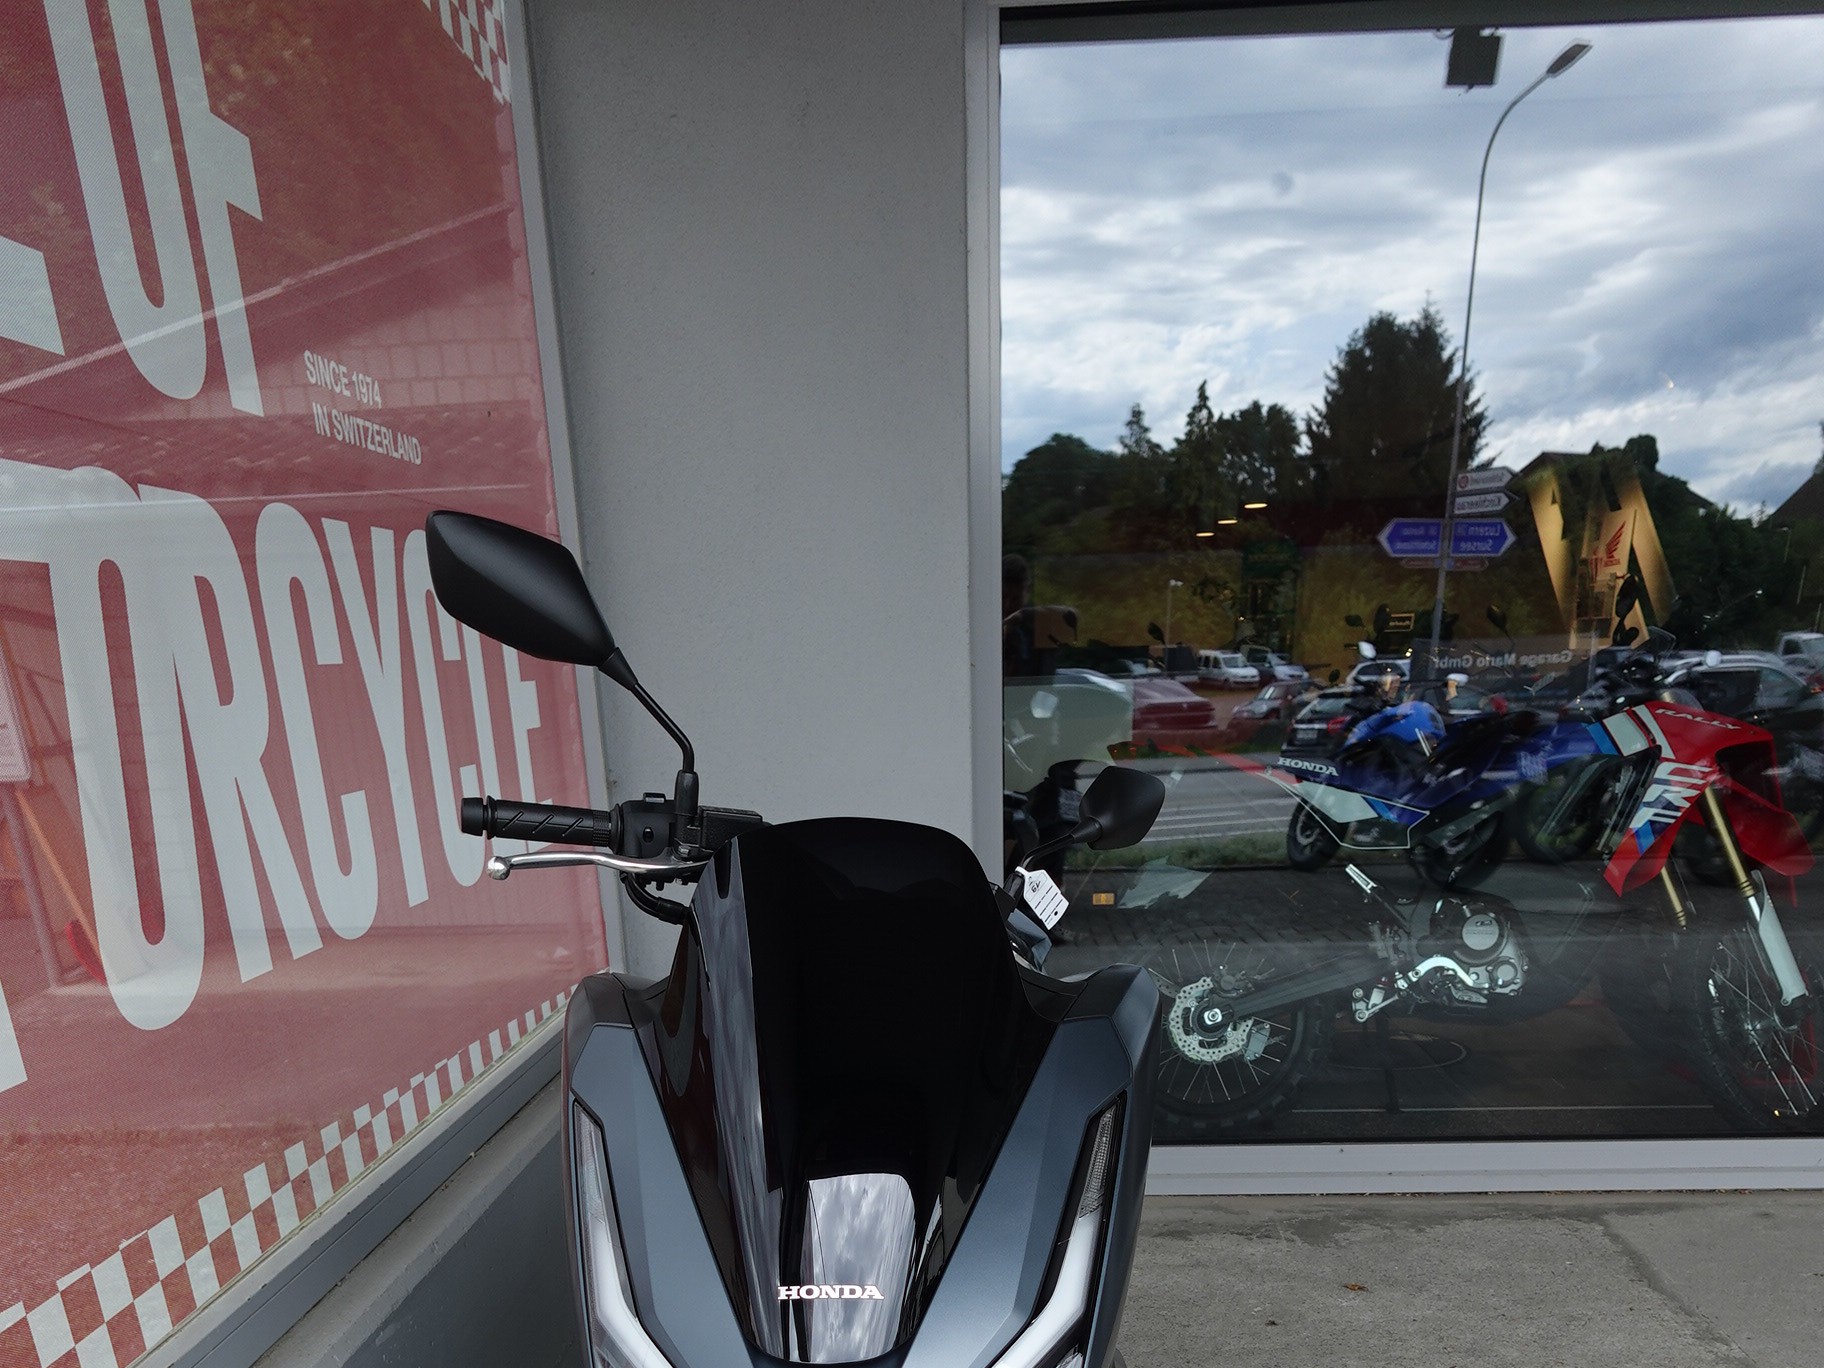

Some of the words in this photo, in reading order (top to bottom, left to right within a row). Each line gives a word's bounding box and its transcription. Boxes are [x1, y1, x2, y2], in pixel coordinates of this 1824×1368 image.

[304, 350, 351, 397] SINCE
[352, 371, 382, 409] 1974
[313, 402, 331, 437] IN
[332, 409, 421, 465] SWITZERLAND
[1655, 708, 1742, 731] RALLY
[1277, 757, 1339, 777] HONDA
[777, 1284, 885, 1300] HONDA
